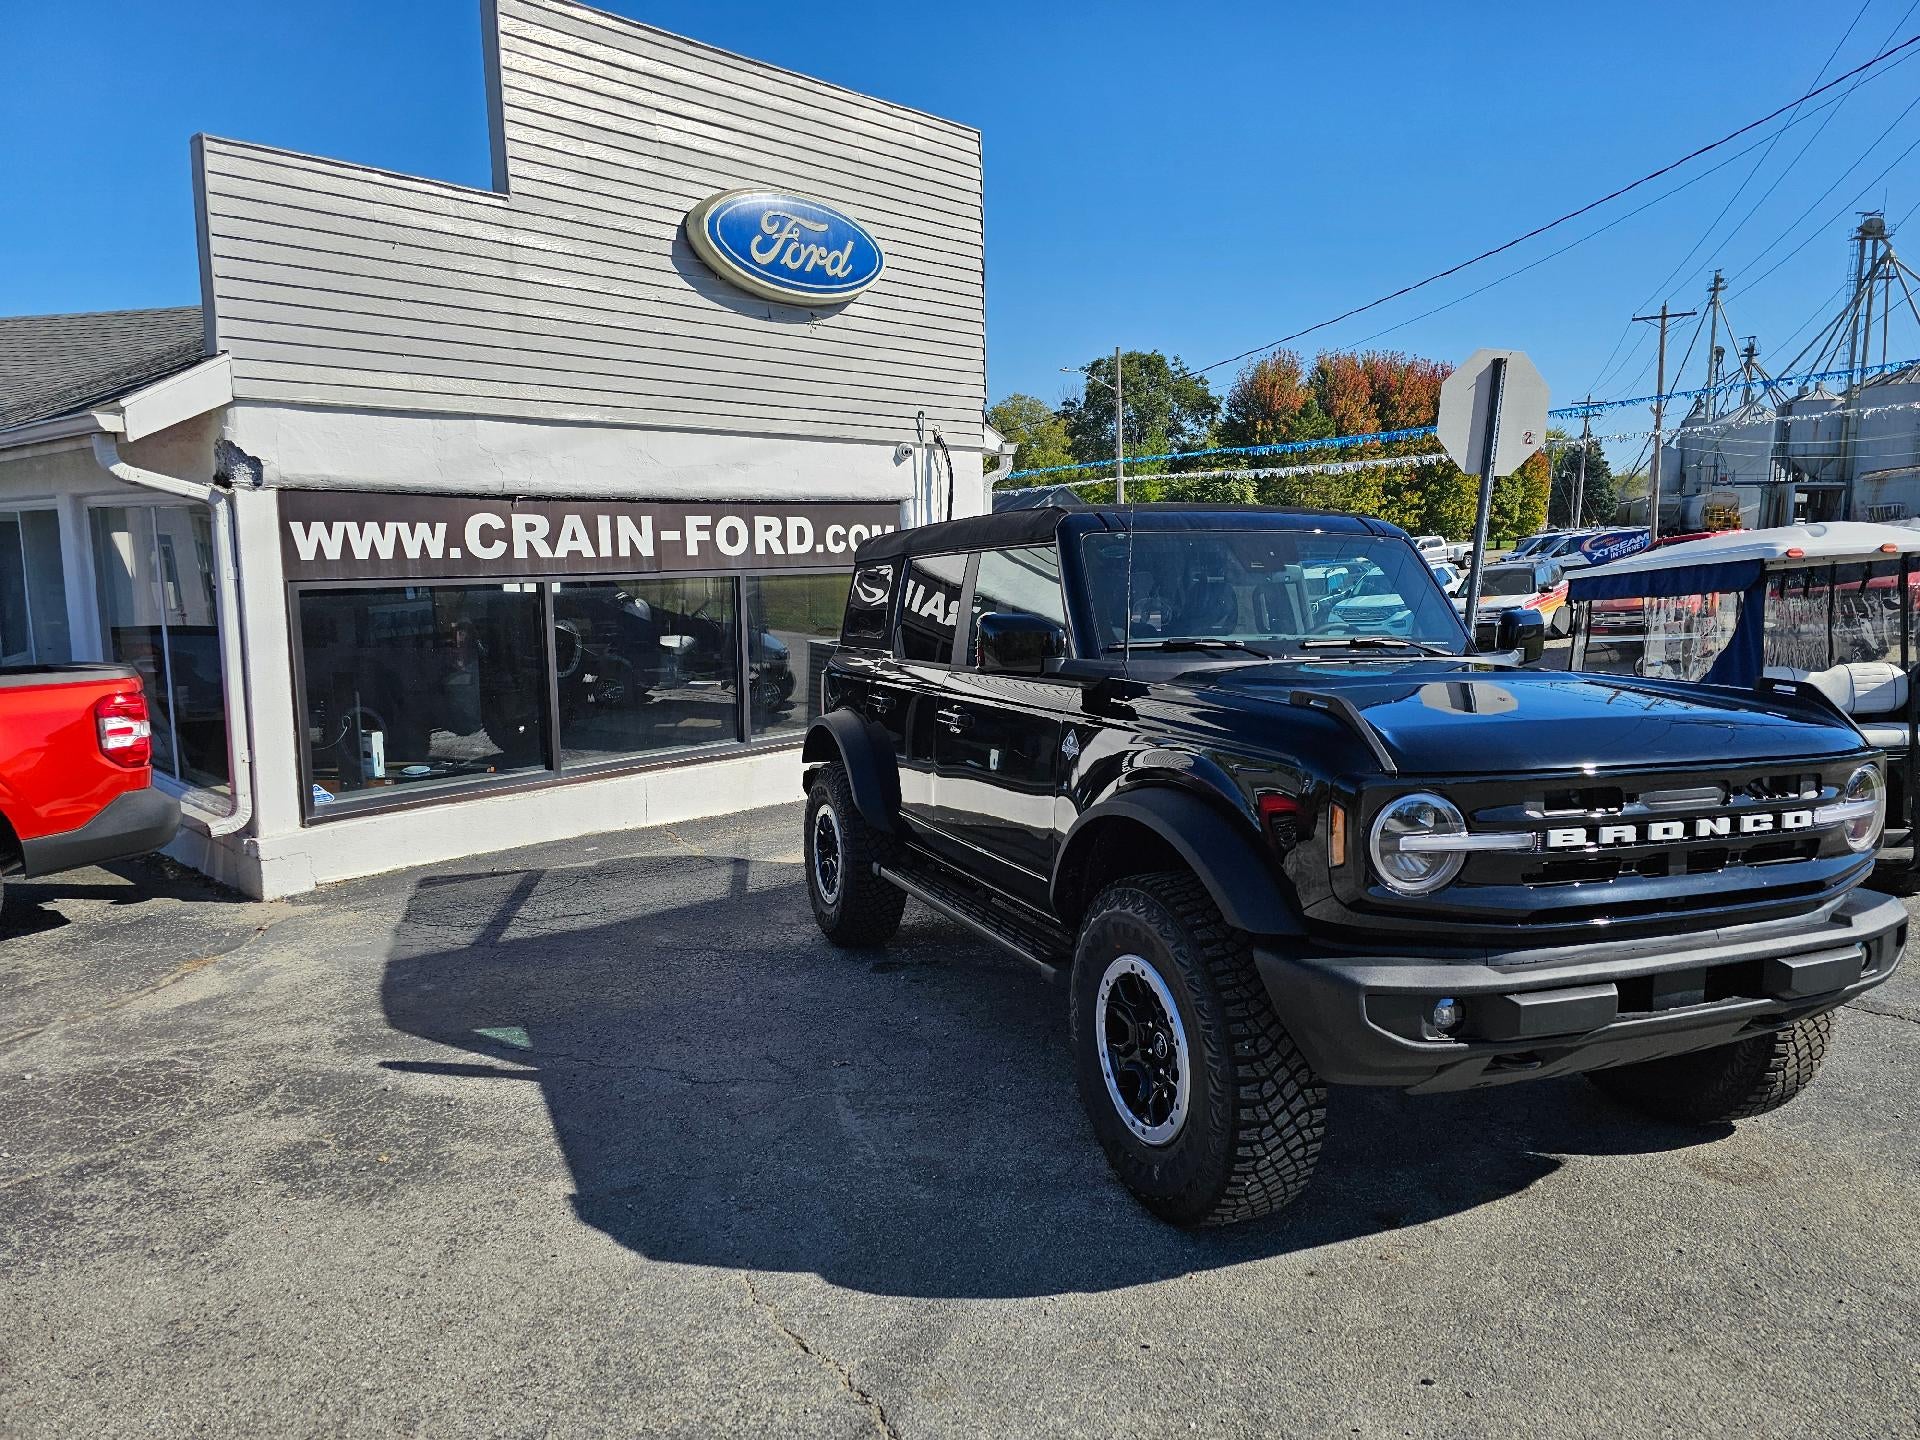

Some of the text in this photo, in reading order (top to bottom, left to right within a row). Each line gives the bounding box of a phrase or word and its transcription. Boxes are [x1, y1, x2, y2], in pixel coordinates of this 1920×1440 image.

[751, 210, 853, 278] Ford
[1592, 532, 1650, 560] XTREAM
[1611, 541, 1645, 559] INTERNET
[1547, 810, 1812, 848] BRONCO
